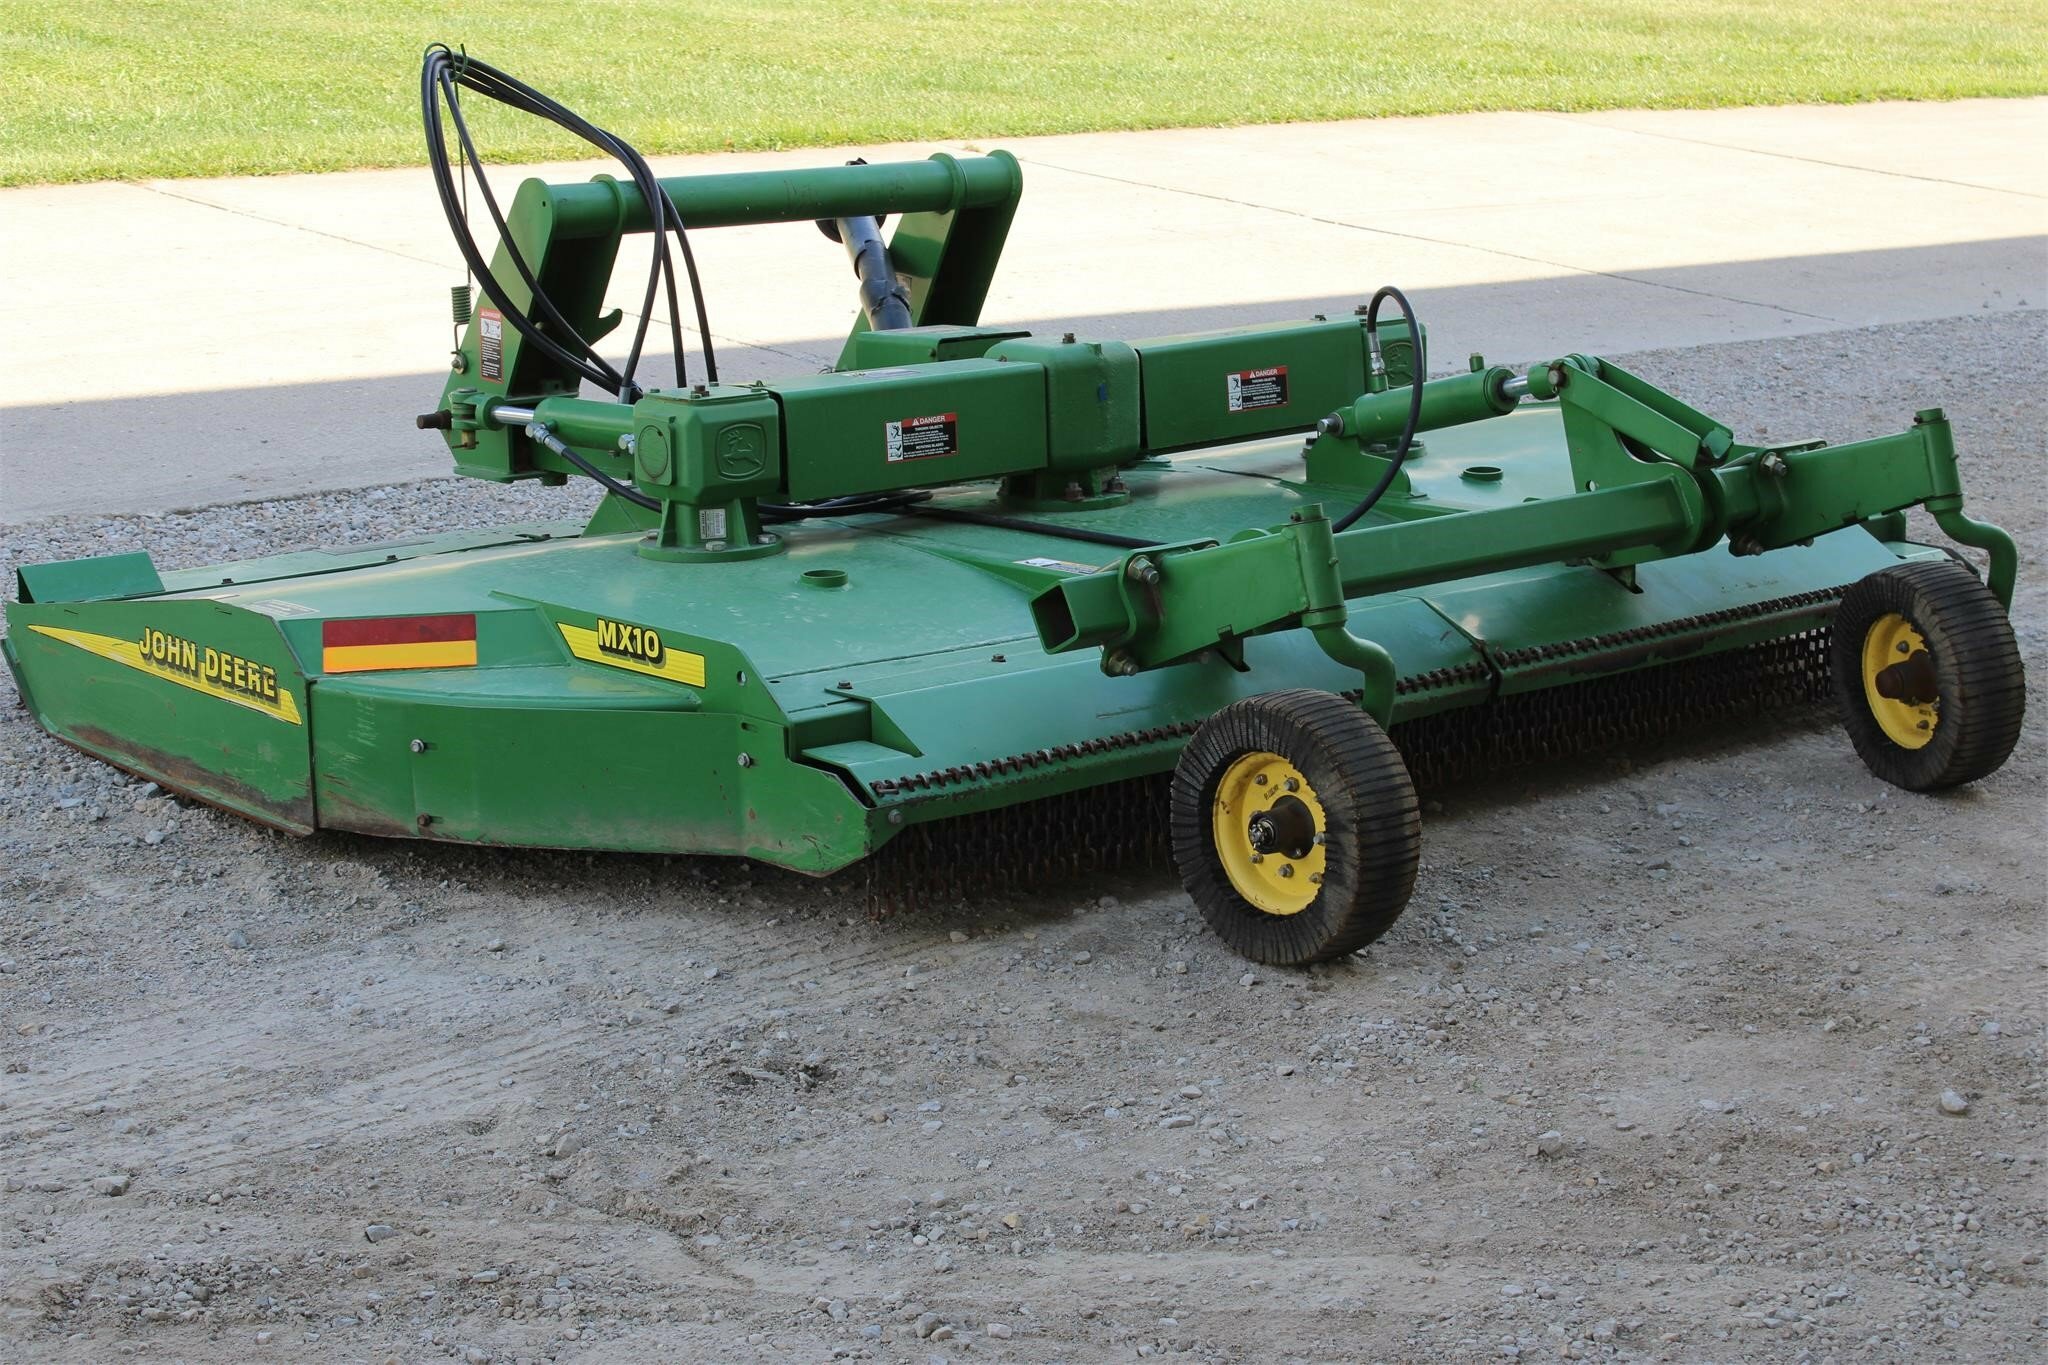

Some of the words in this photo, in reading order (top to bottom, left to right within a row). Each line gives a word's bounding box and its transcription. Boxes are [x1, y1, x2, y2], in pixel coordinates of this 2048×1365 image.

[1255, 368, 1278, 377] DANGER
[919, 415, 946, 425] DANGER
[598, 618, 662, 661] MX10
[139, 627, 197, 673] JOHN
[205, 647, 277, 699] DEERE
